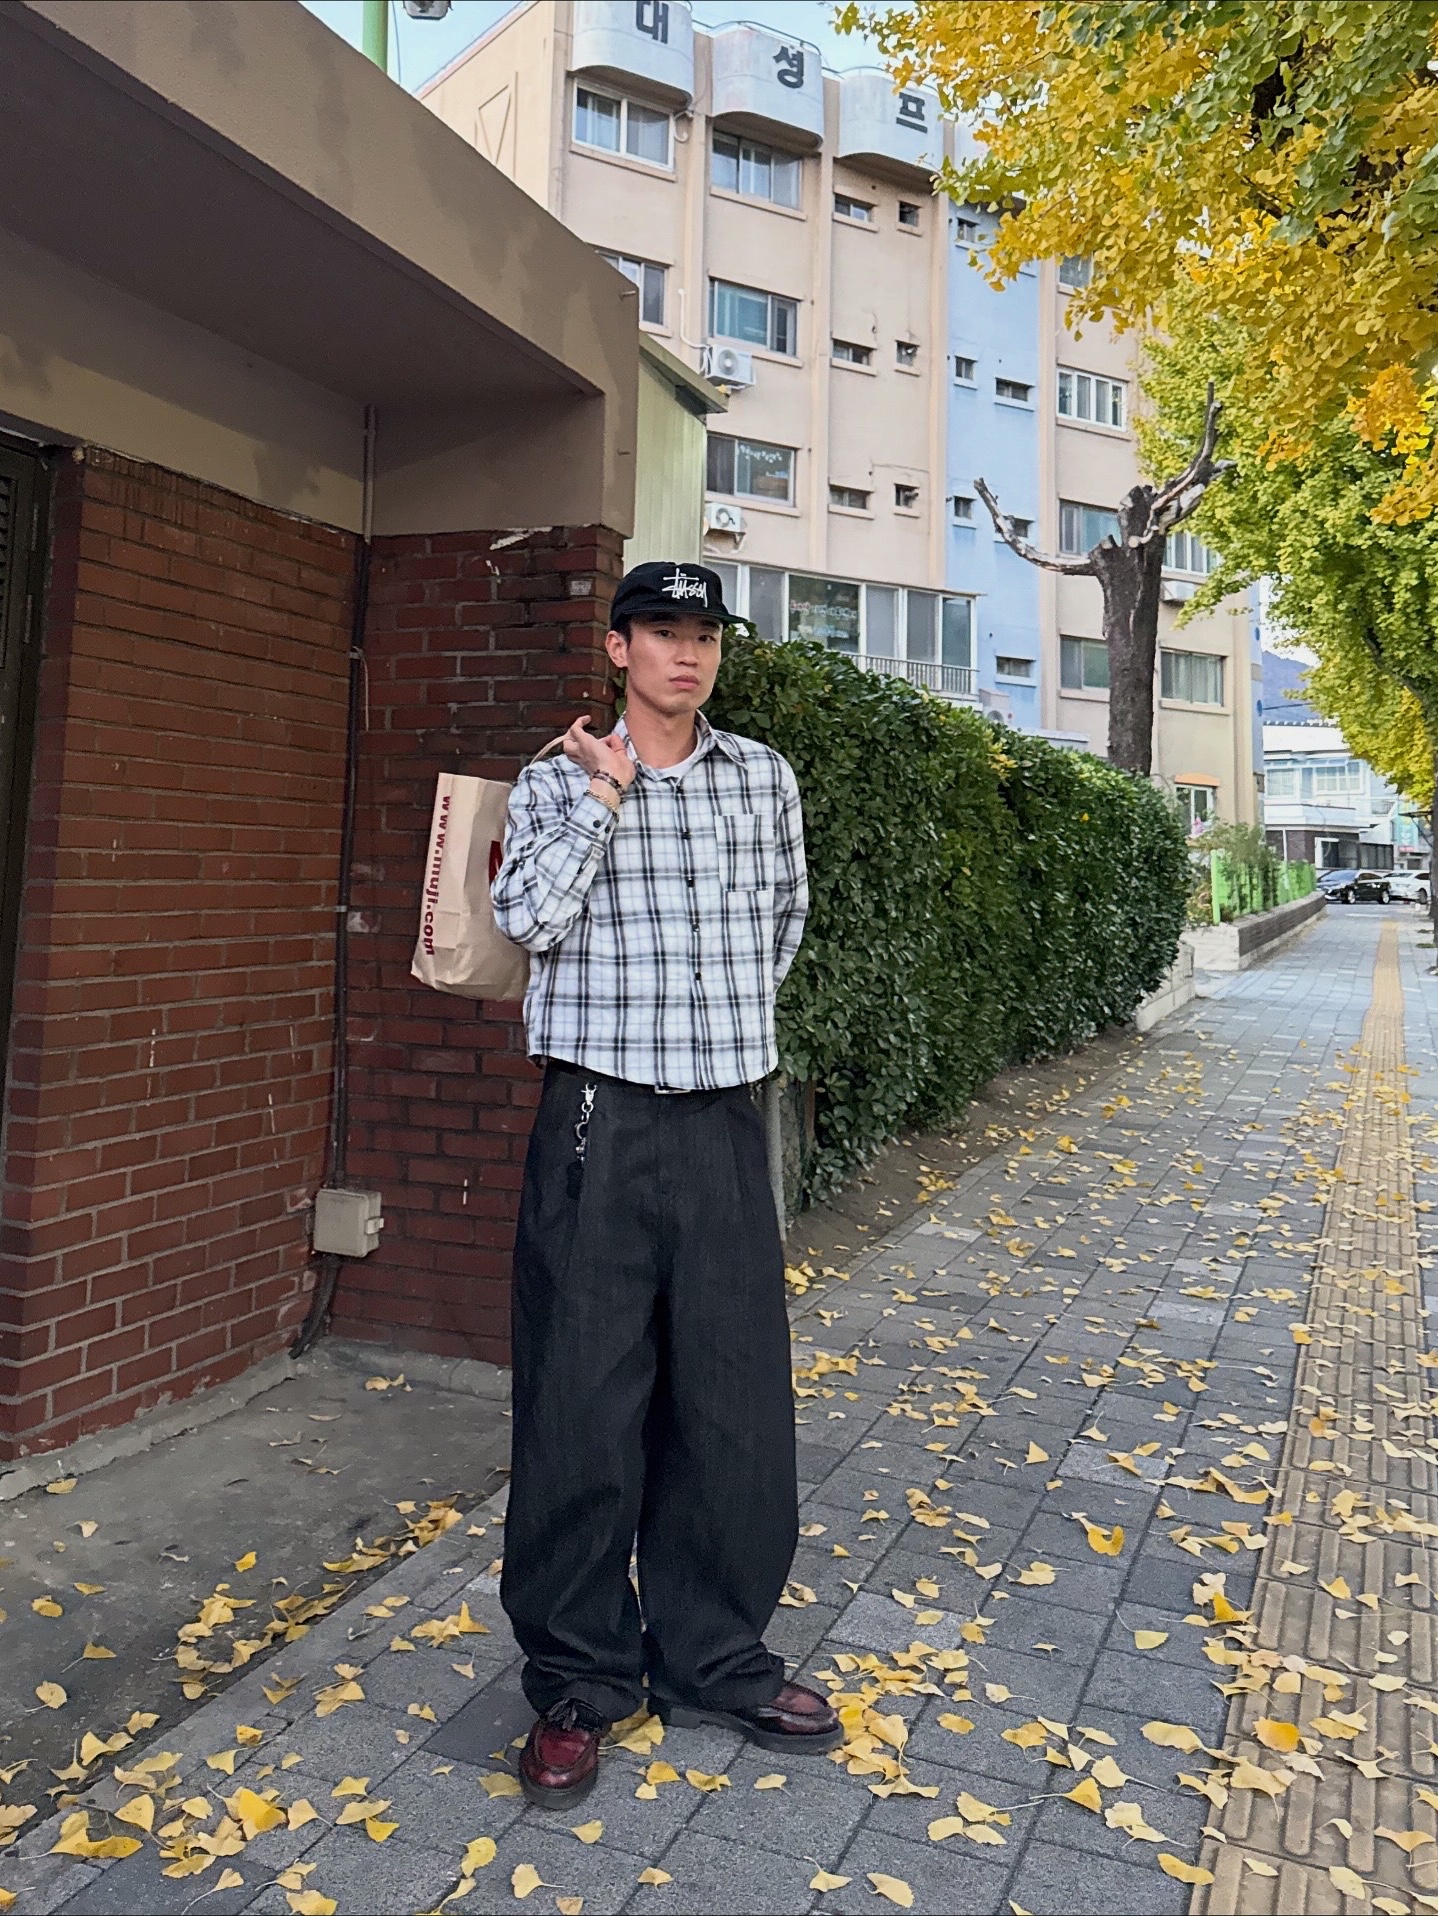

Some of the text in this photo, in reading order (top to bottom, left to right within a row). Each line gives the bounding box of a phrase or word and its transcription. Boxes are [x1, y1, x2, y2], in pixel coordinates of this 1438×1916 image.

[636, 1, 669, 45] 대
[772, 45, 804, 89] 성
[423, 795, 451, 956] www.muji.com
